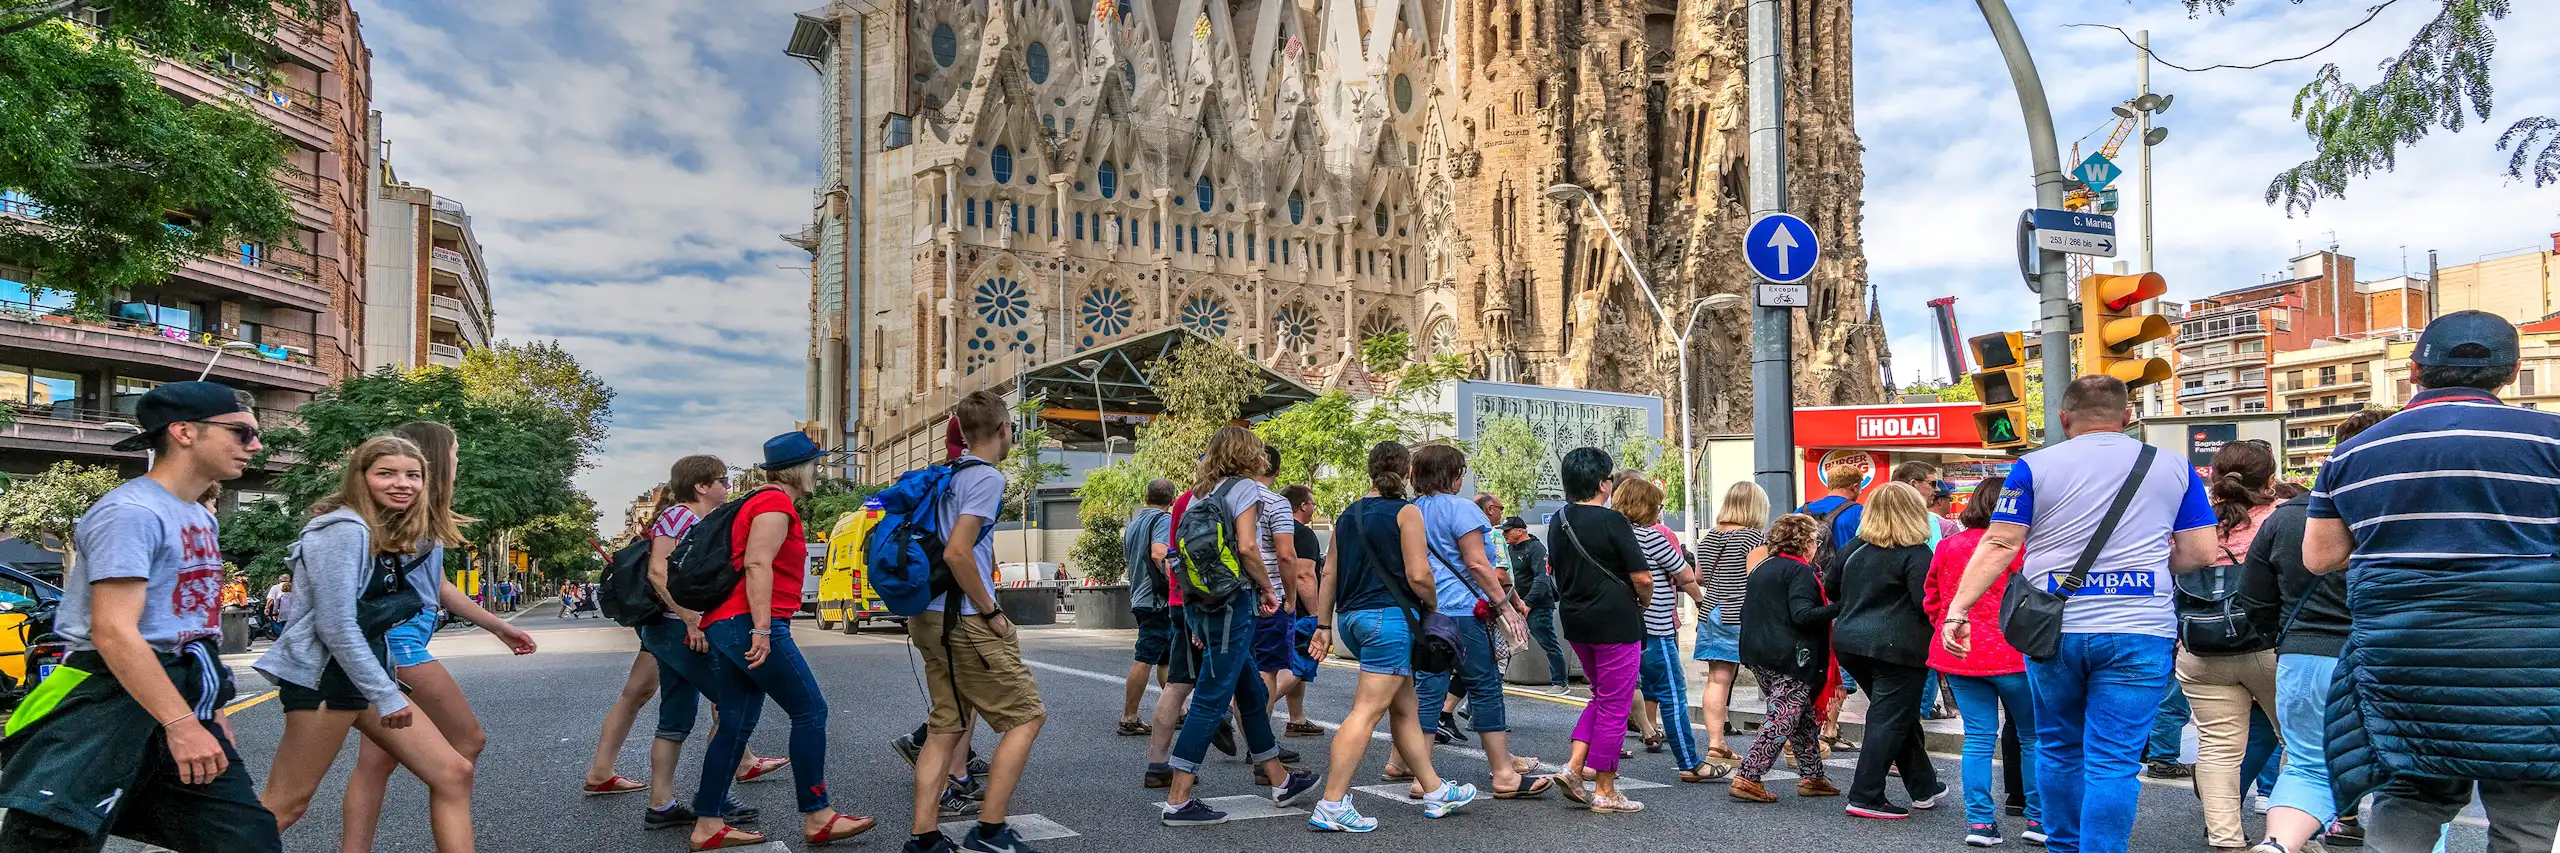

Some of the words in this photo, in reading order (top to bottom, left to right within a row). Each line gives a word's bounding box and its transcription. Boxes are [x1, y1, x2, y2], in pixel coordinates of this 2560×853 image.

[2084, 163, 2109, 182] W
[2073, 216, 2083, 226] C.
[2085, 217, 2112, 230] Marina
[2050, 236, 2063, 245] 253
[2083, 239, 2093, 248] bis
[1860, 418, 1936, 437] ¡HOLA!
[2081, 573, 2152, 588] MBAR
